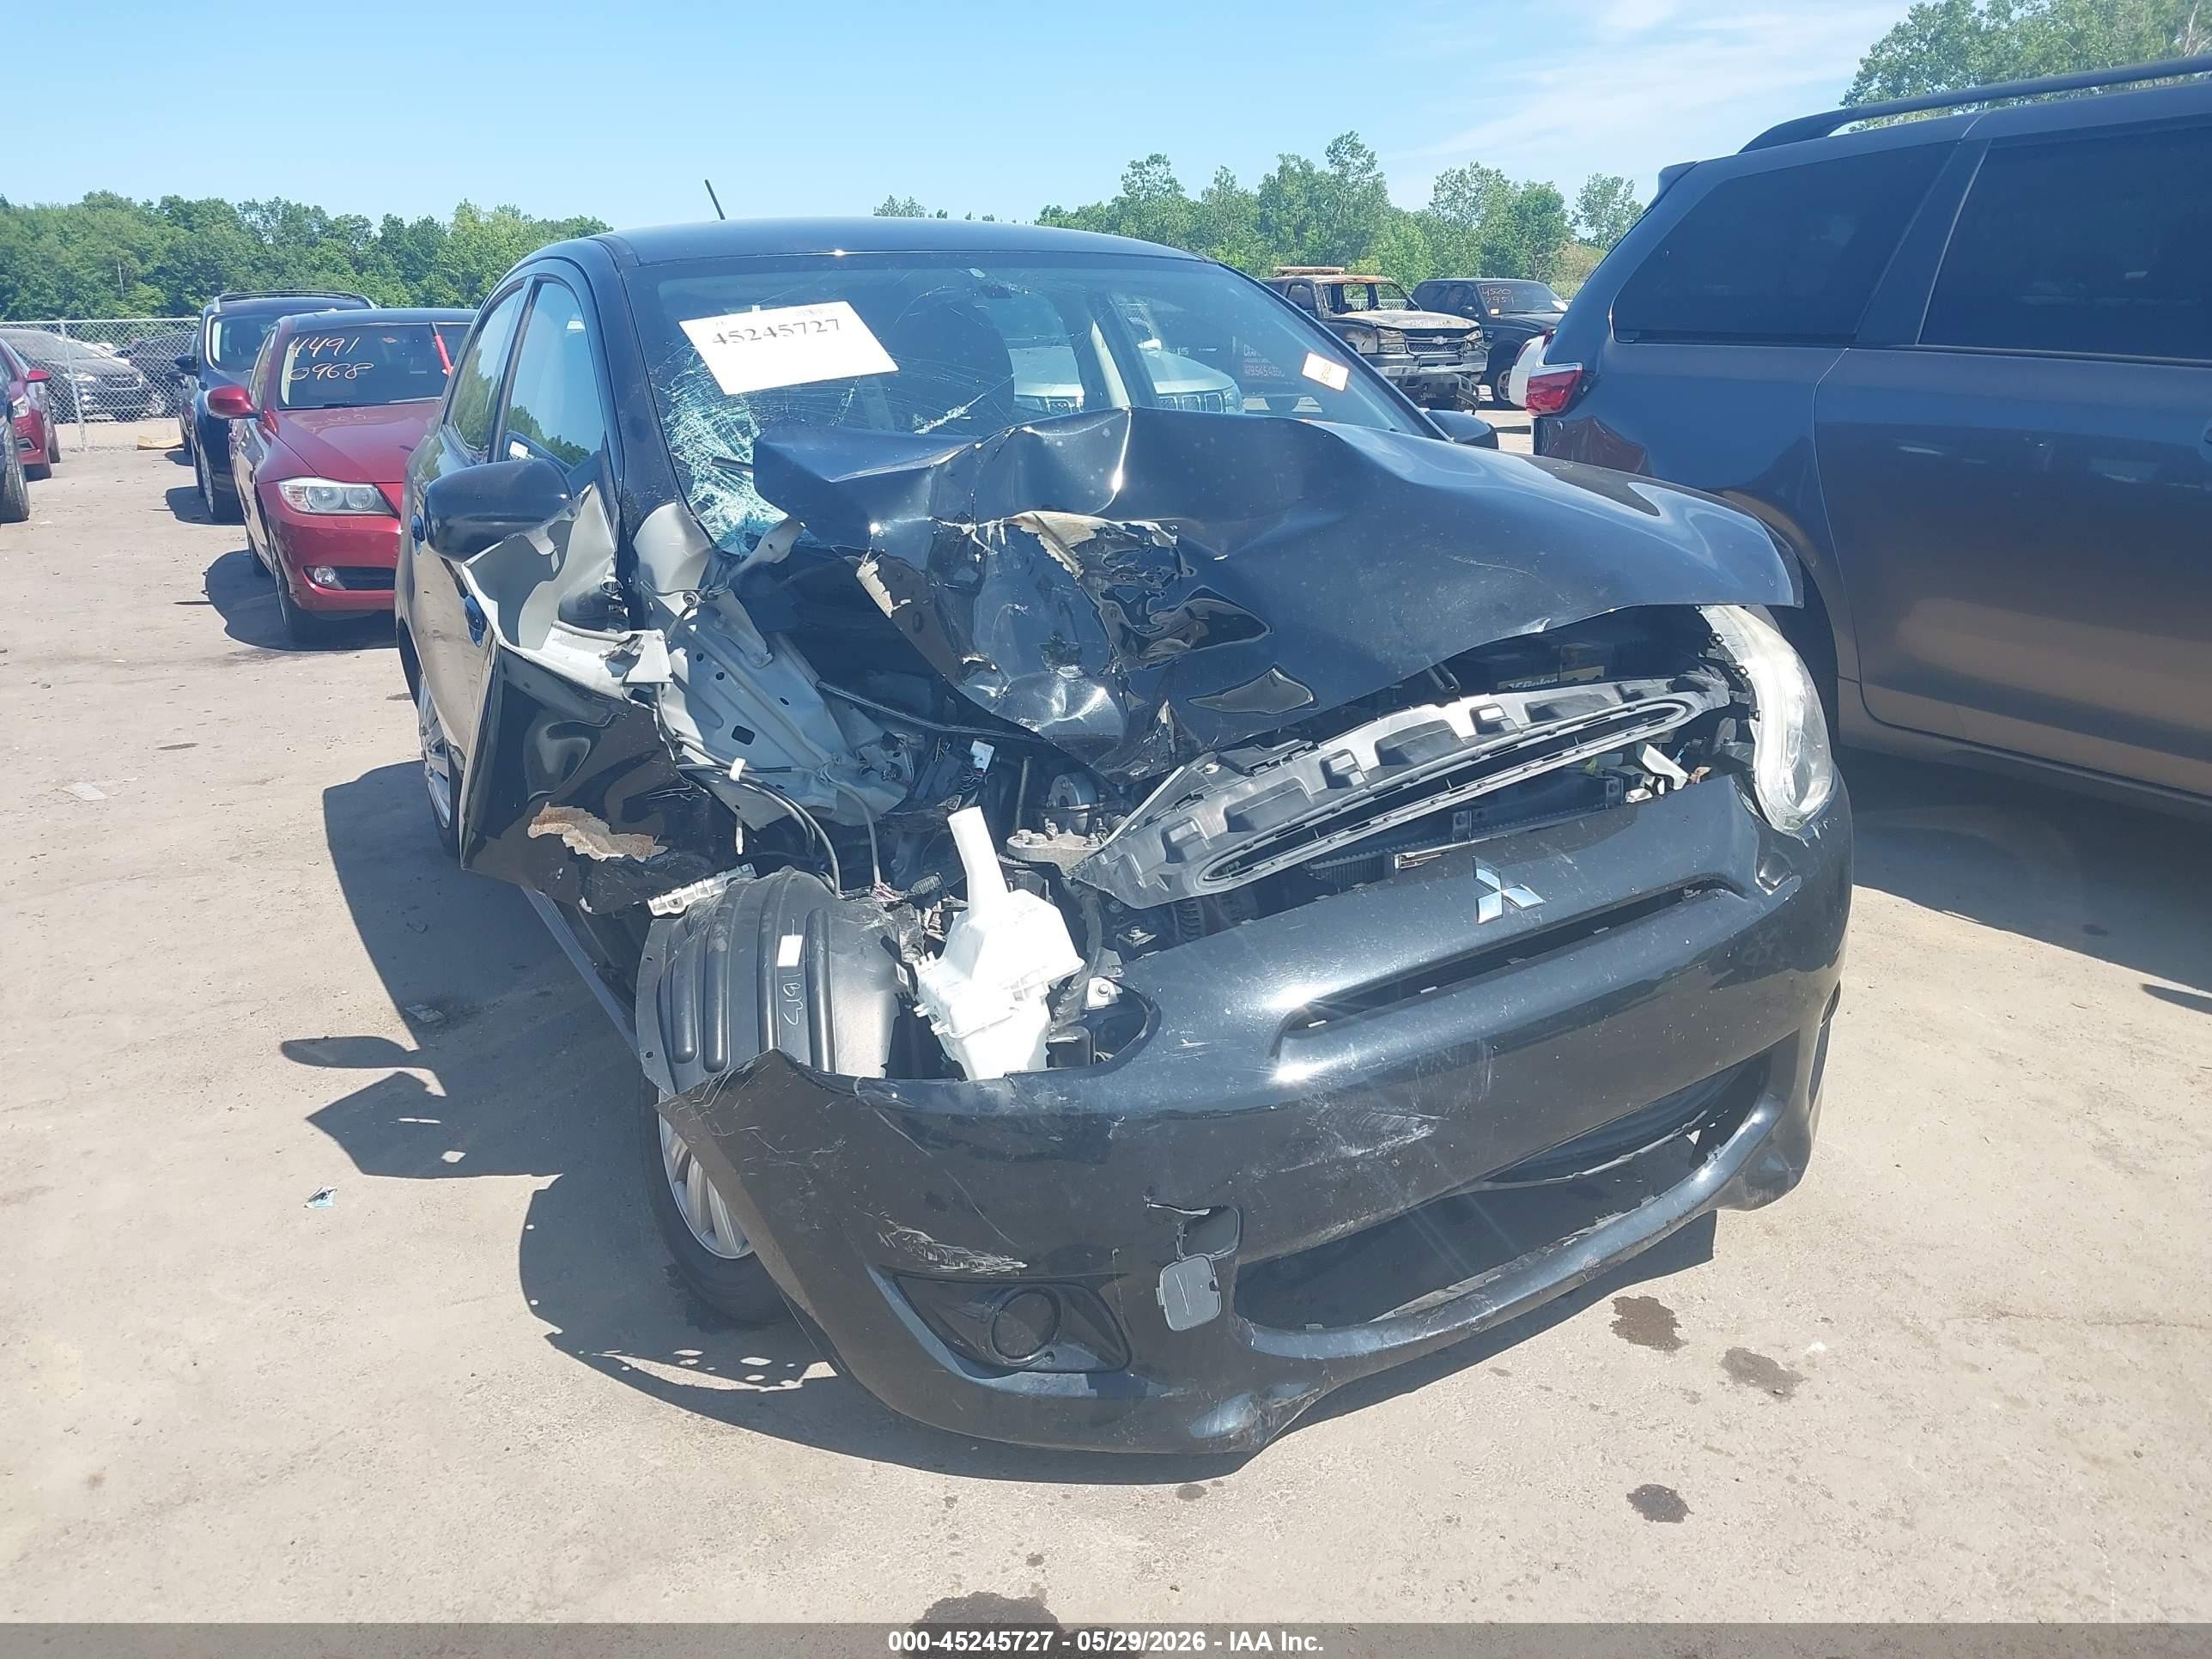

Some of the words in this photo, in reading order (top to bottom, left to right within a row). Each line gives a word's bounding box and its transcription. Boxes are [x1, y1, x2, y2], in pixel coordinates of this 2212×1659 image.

[714, 319, 840, 344] 45245727
[289, 337, 360, 356] 4491
[289, 363, 374, 380] 0968
